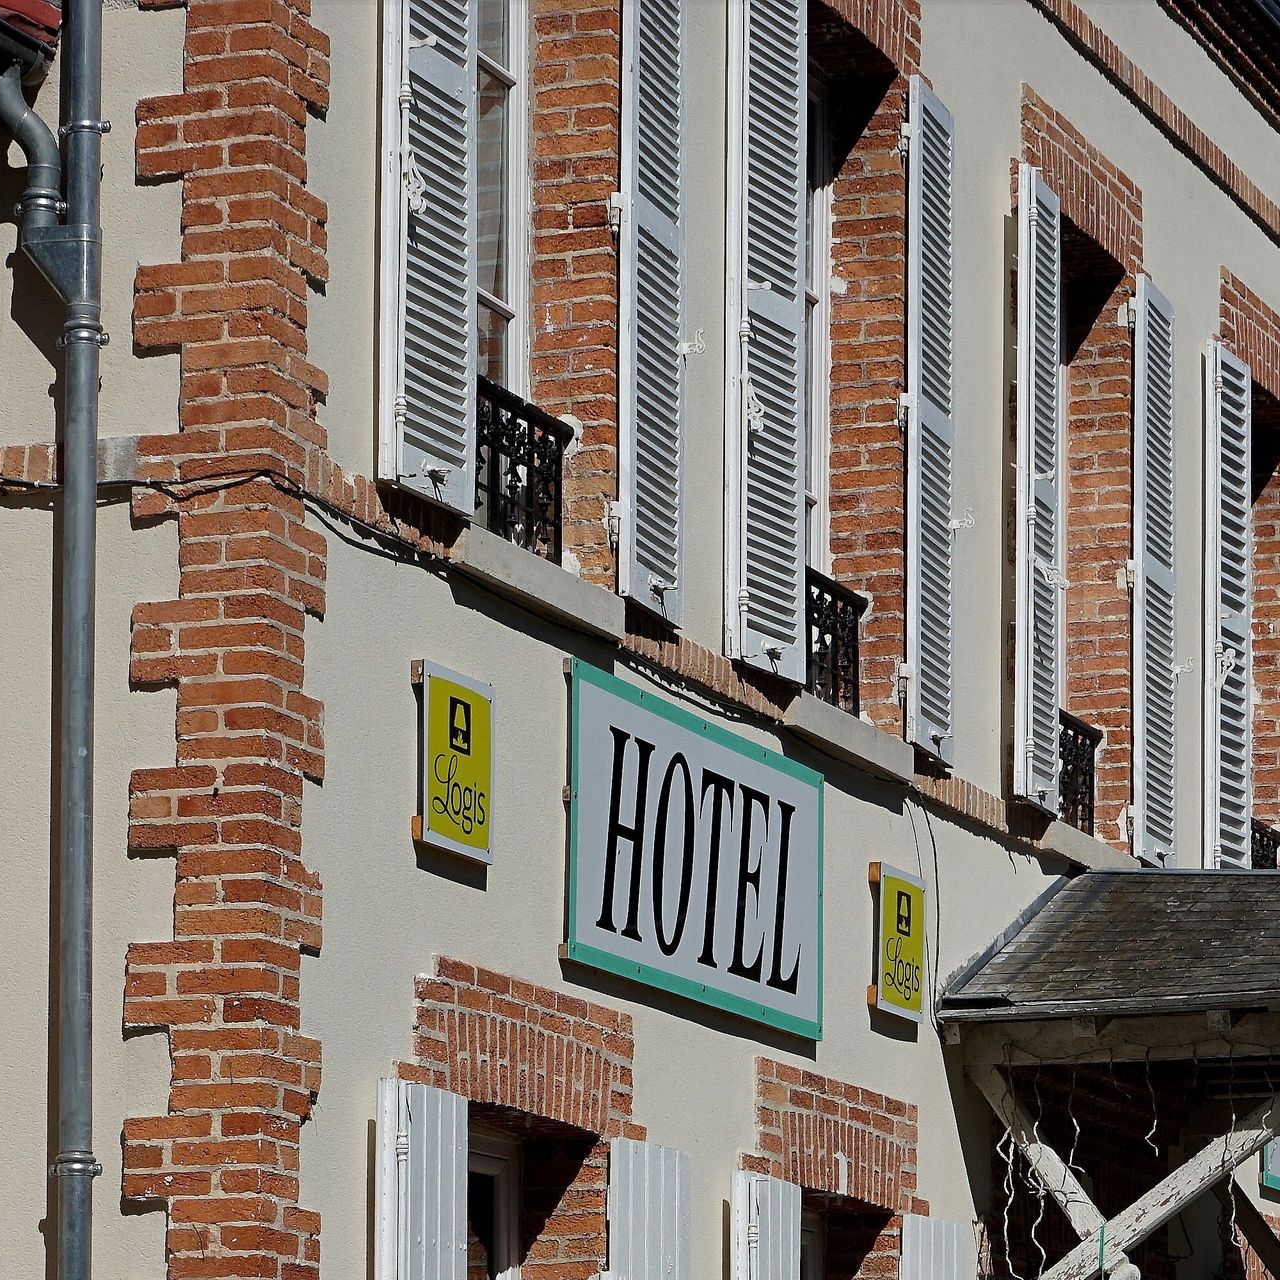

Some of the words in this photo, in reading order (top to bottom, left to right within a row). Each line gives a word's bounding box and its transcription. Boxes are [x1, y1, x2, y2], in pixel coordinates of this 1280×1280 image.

[432, 753, 486, 835] Logis
[596, 724, 803, 995] HOTEL
[884, 936, 920, 1001] Logis
